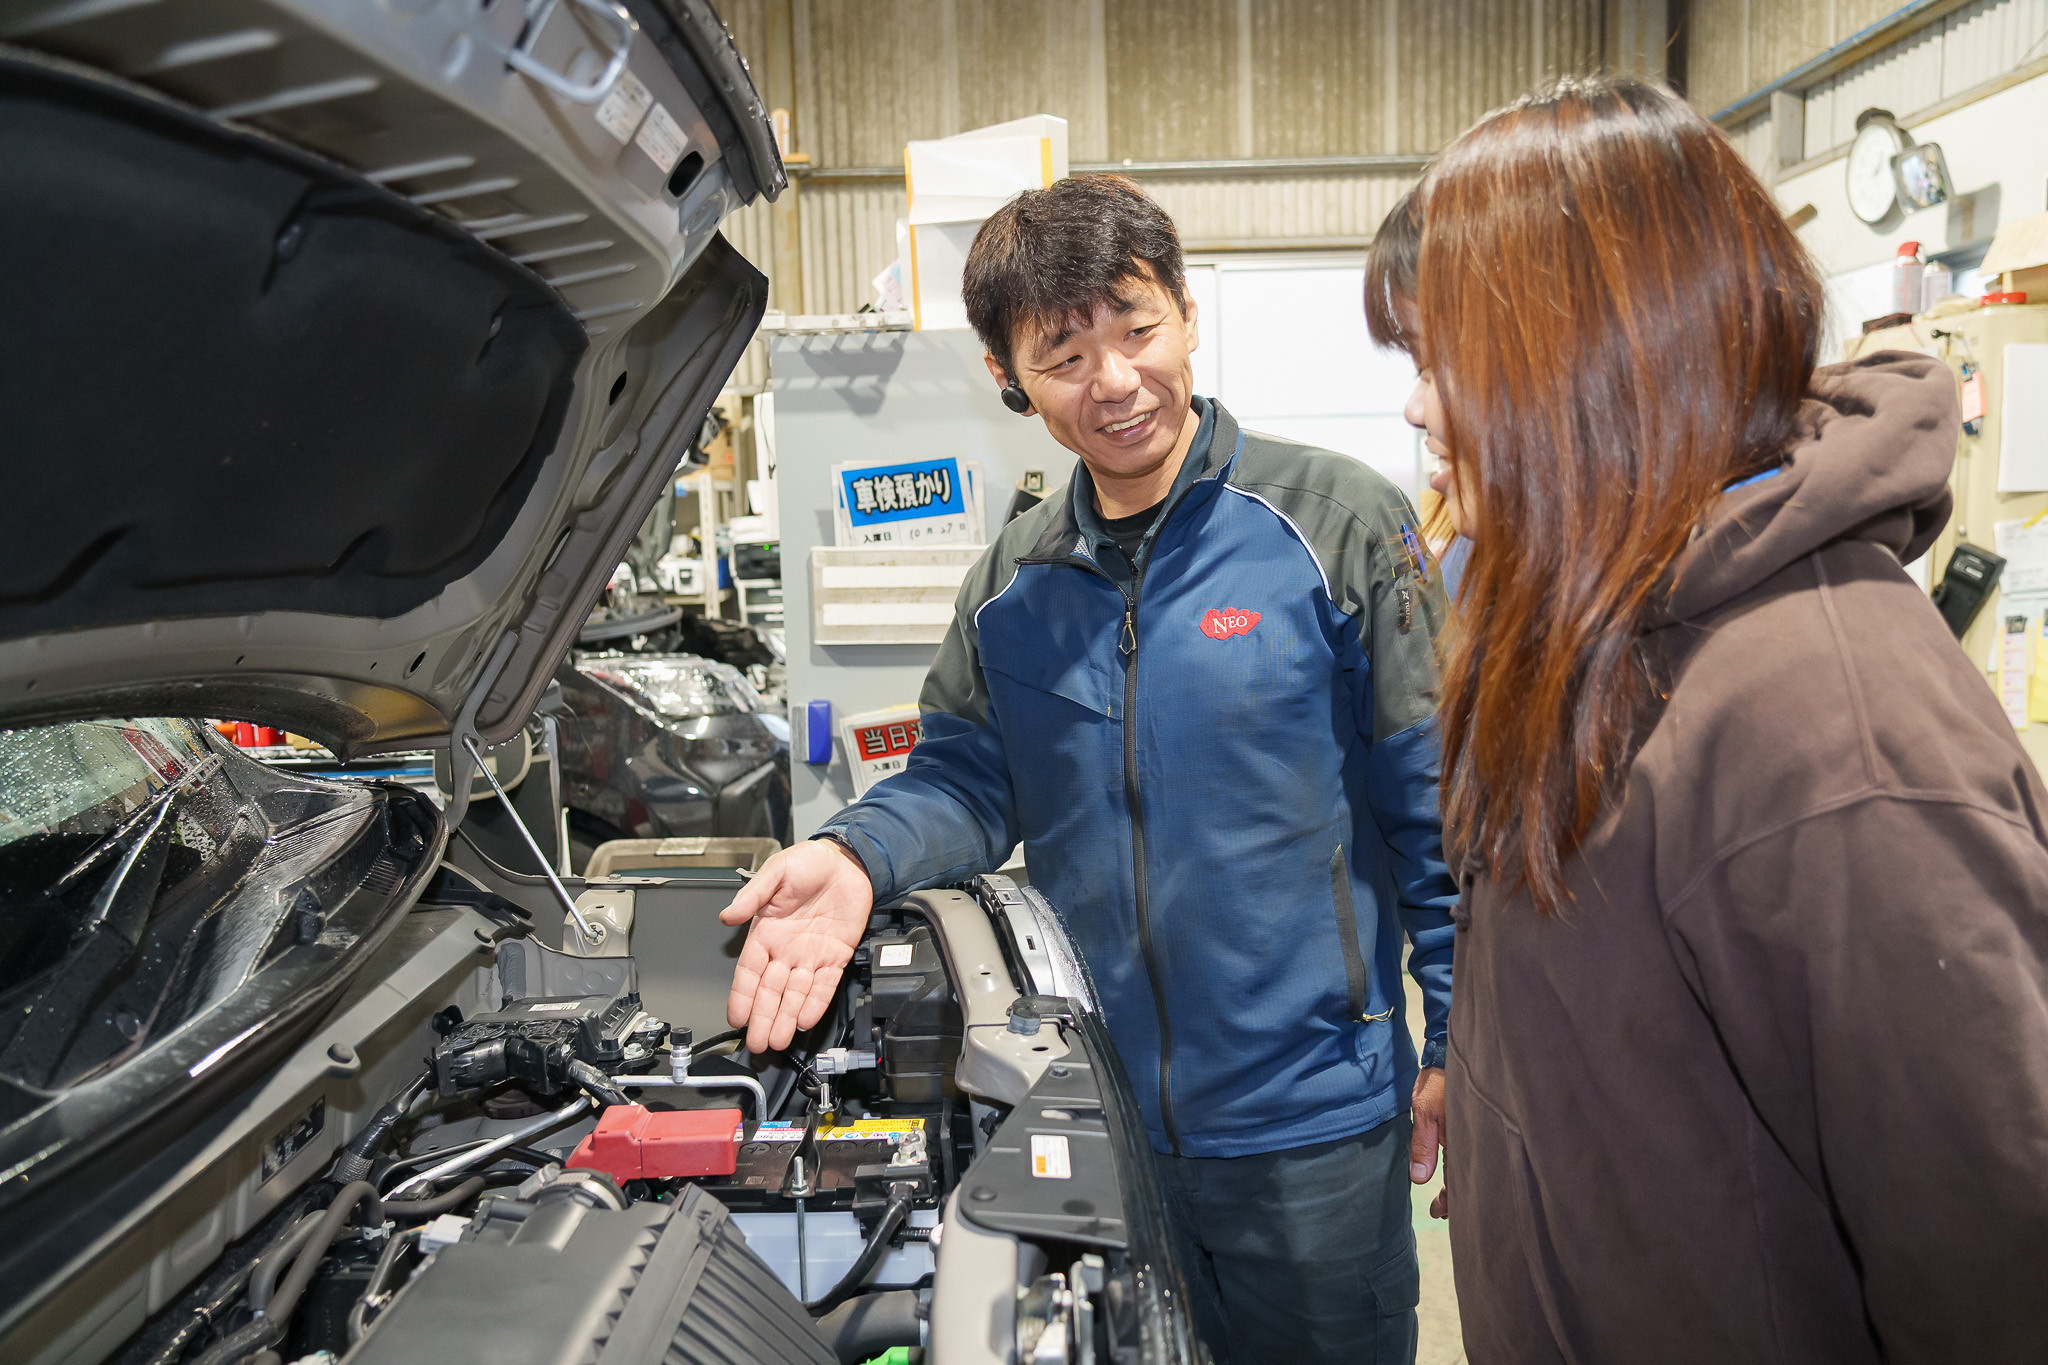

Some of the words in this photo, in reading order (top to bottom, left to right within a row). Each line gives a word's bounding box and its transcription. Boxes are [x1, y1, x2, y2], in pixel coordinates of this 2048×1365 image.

[852, 468, 952, 515] 車検預かり
[1212, 615, 1248, 634] NEO
